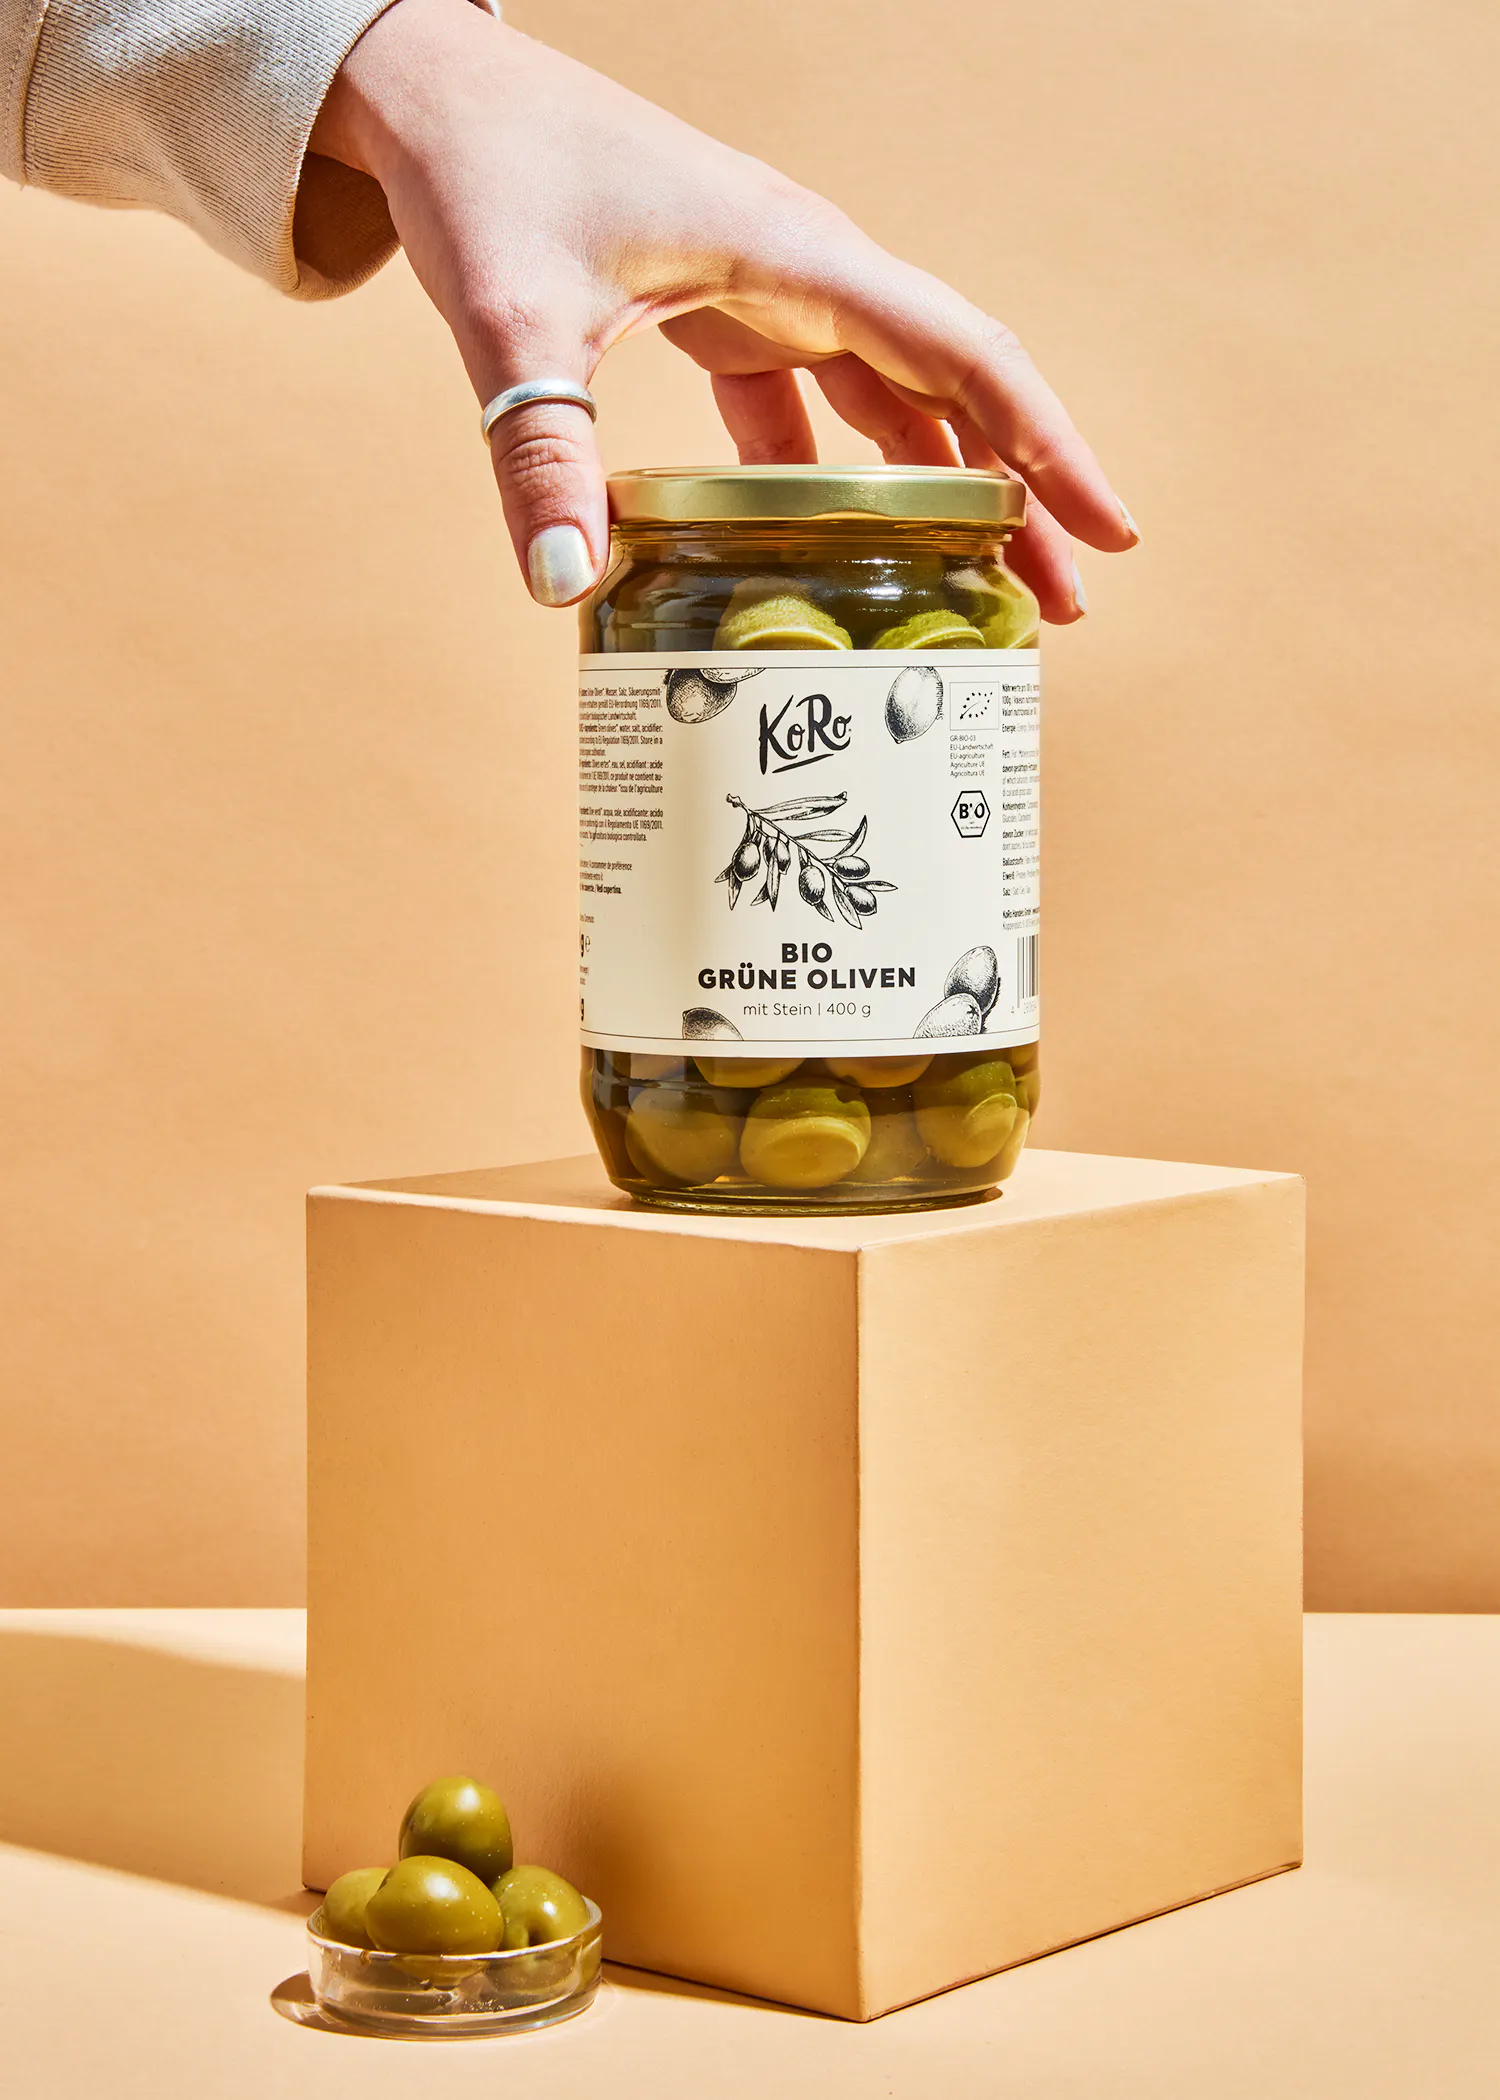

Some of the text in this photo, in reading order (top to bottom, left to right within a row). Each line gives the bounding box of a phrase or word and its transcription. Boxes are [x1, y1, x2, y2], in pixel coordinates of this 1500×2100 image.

[640, 736, 654, 744] Store
[654, 736, 658, 744] in
[758, 694, 852, 775] KoRo
[650, 760, 663, 769] acide
[650, 808, 663, 817] acido
[781, 942, 833, 963] BIO
[698, 962, 916, 990] GRÜNE OLIVEN
[743, 1003, 768, 1016] mit
[773, 1002, 812, 1016] Stein
[826, 1002, 857, 1016] 400
[862, 1006, 871, 1017] g
